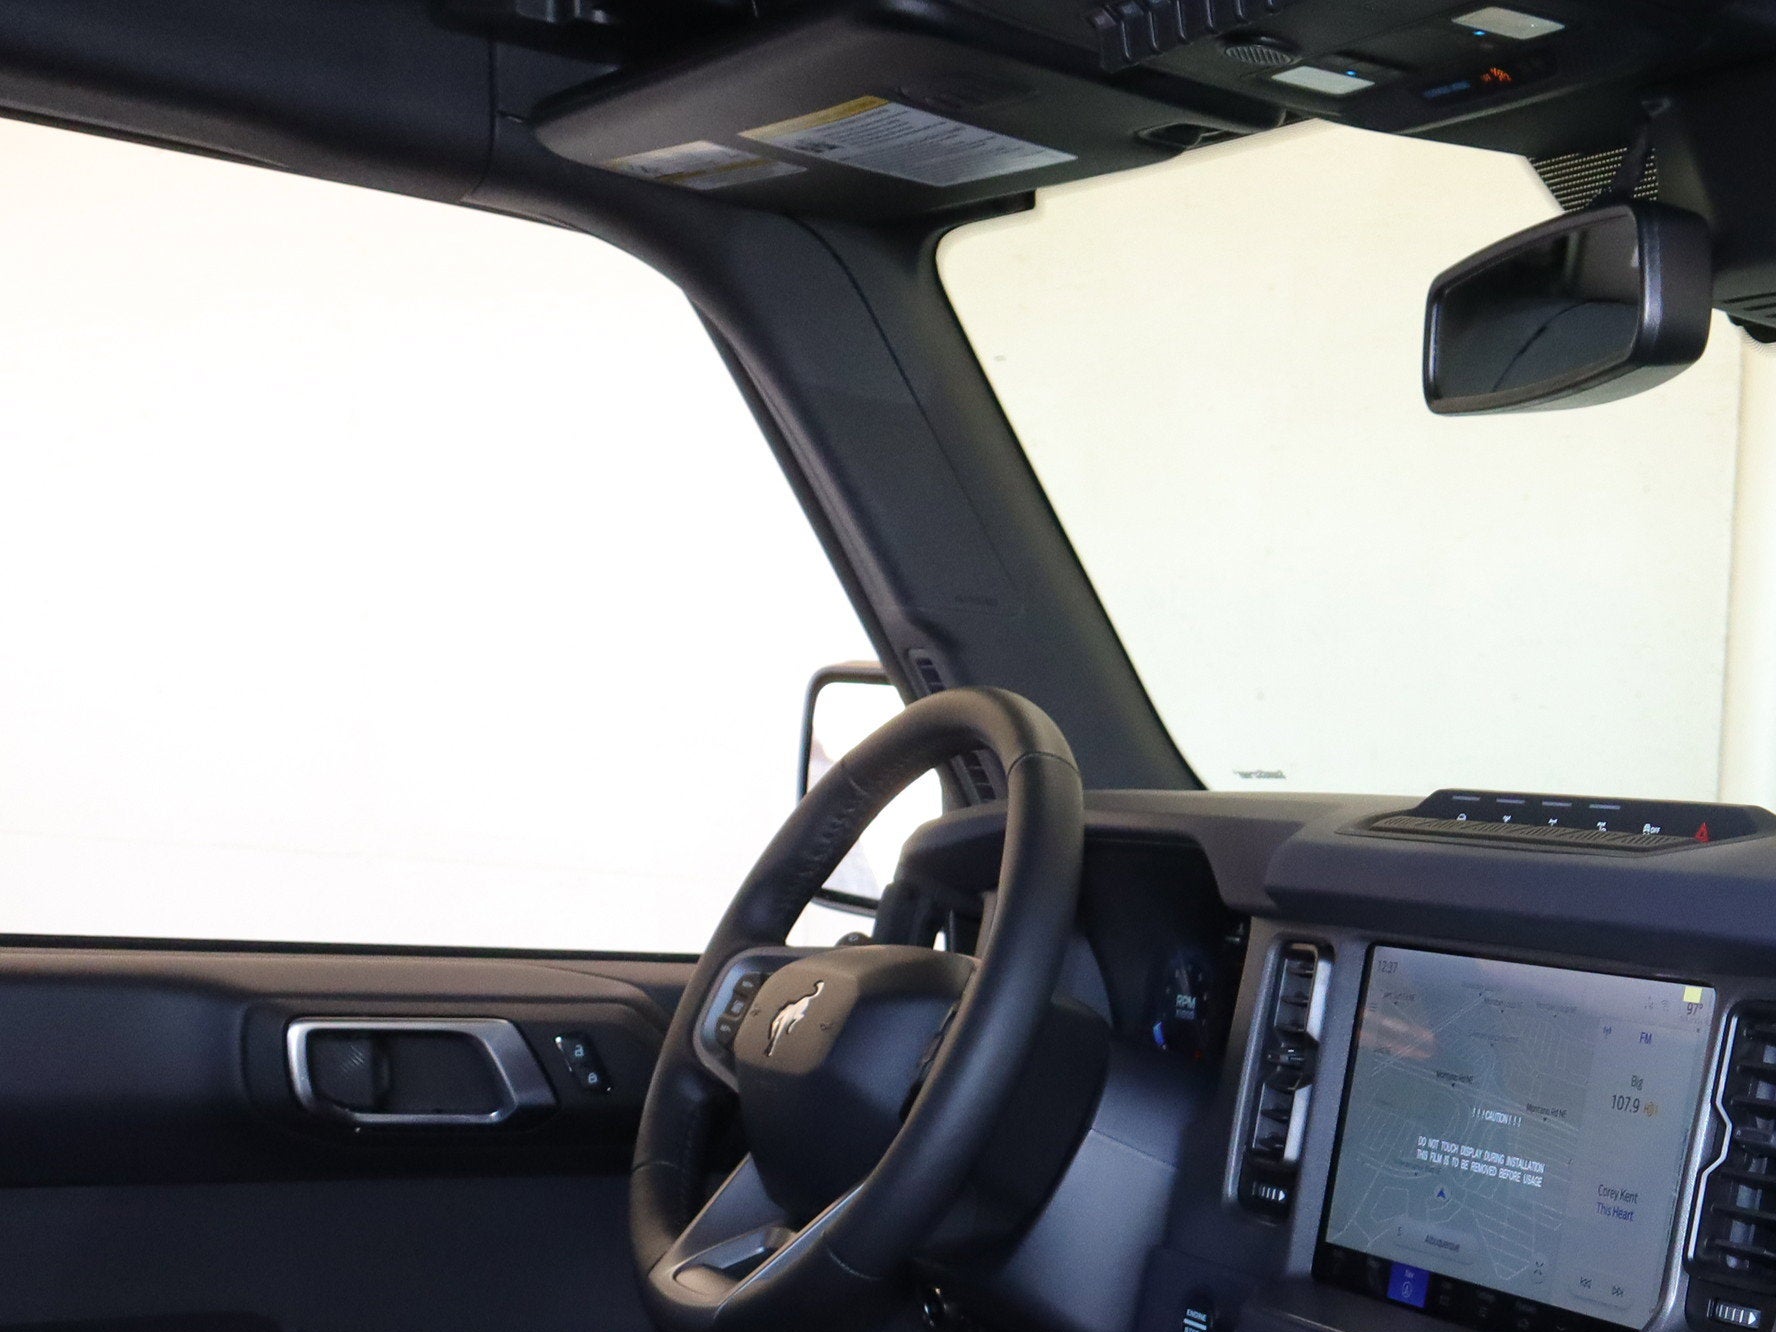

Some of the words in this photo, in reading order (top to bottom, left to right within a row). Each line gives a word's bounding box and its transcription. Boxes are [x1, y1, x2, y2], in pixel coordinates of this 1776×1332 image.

[1176, 994, 1197, 1009] RPM
[1639, 1031, 1653, 1044] FM
[1611, 1094, 1641, 1113] 107.9
[1417, 1135, 1427, 1147] DO
[1428, 1138, 1440, 1150] NOT
[1441, 1140, 1459, 1154] TOUCH
[1460, 1145, 1483, 1159] DISPLAY
[1483, 1150, 1505, 1165] DURING
[1505, 1155, 1546, 1174] INSTALLATION
[1416, 1148, 1428, 1161] THIS
[1430, 1151, 1442, 1163] FILM
[1443, 1154, 1450, 1166] IS
[1451, 1156, 1460, 1168] TO
[1460, 1159, 1470, 1170] BE
[1470, 1161, 1498, 1177] REMOVED
[1498, 1167, 1521, 1183] BEFORE
[1522, 1173, 1543, 1188] USAGE
[1597, 1184, 1619, 1201] Corey
[1620, 1188, 1638, 1204] Kent
[1596, 1201, 1611, 1216] This
[1186, 1308, 1207, 1322] ENGINE
